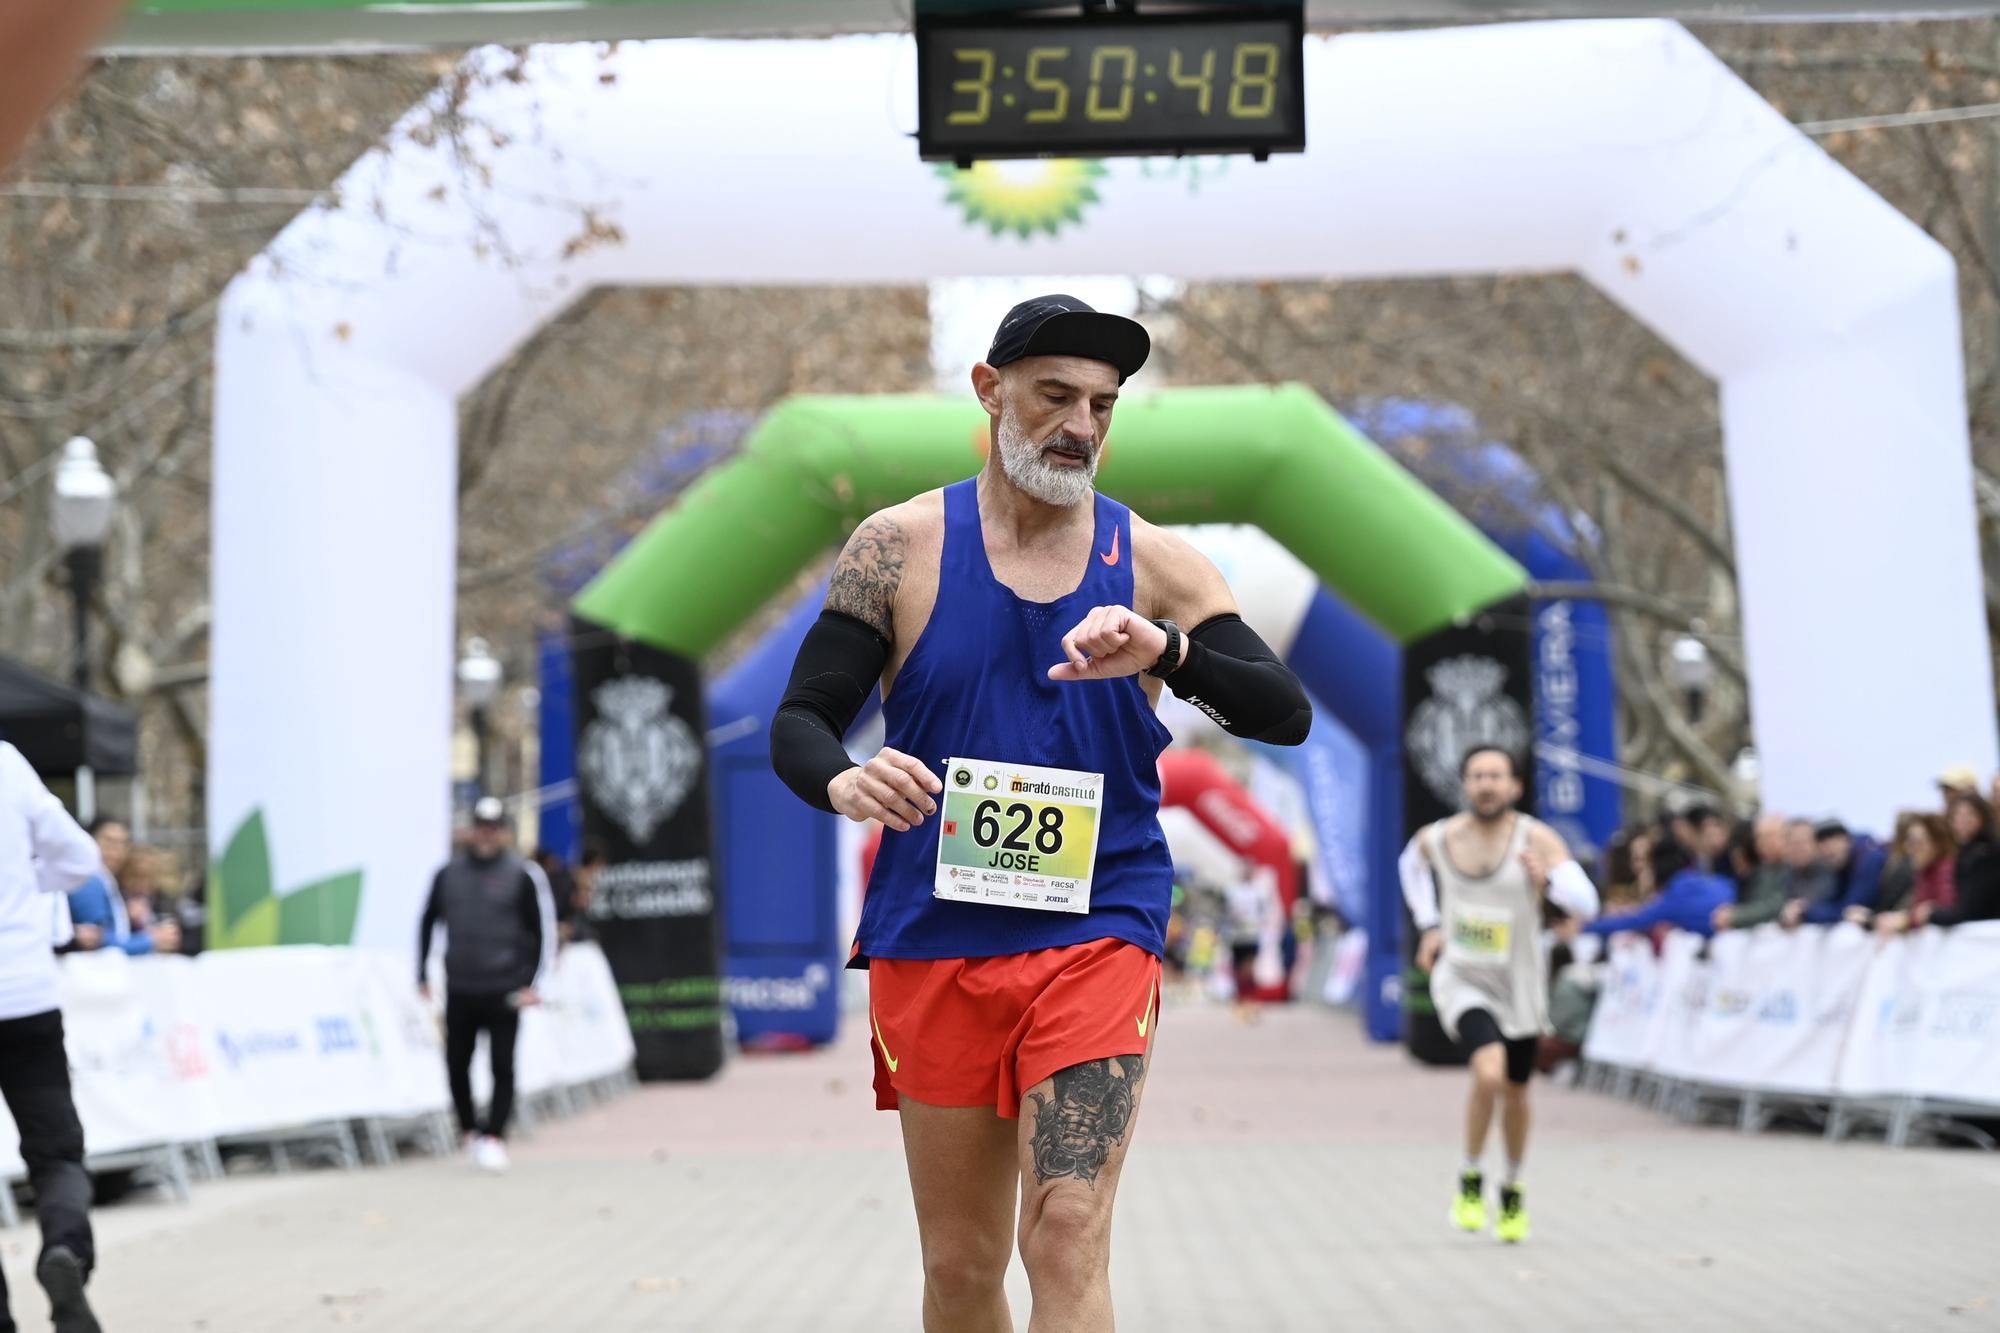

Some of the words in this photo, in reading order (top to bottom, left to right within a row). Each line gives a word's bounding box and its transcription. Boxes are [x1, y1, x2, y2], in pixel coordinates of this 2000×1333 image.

[946, 43, 1279, 124] 3:50:48
[1011, 781, 1050, 795] marató
[1052, 785, 1095, 800] CASTELLÓ
[973, 799, 1064, 855] 628
[989, 851, 1040, 872] JOSE
